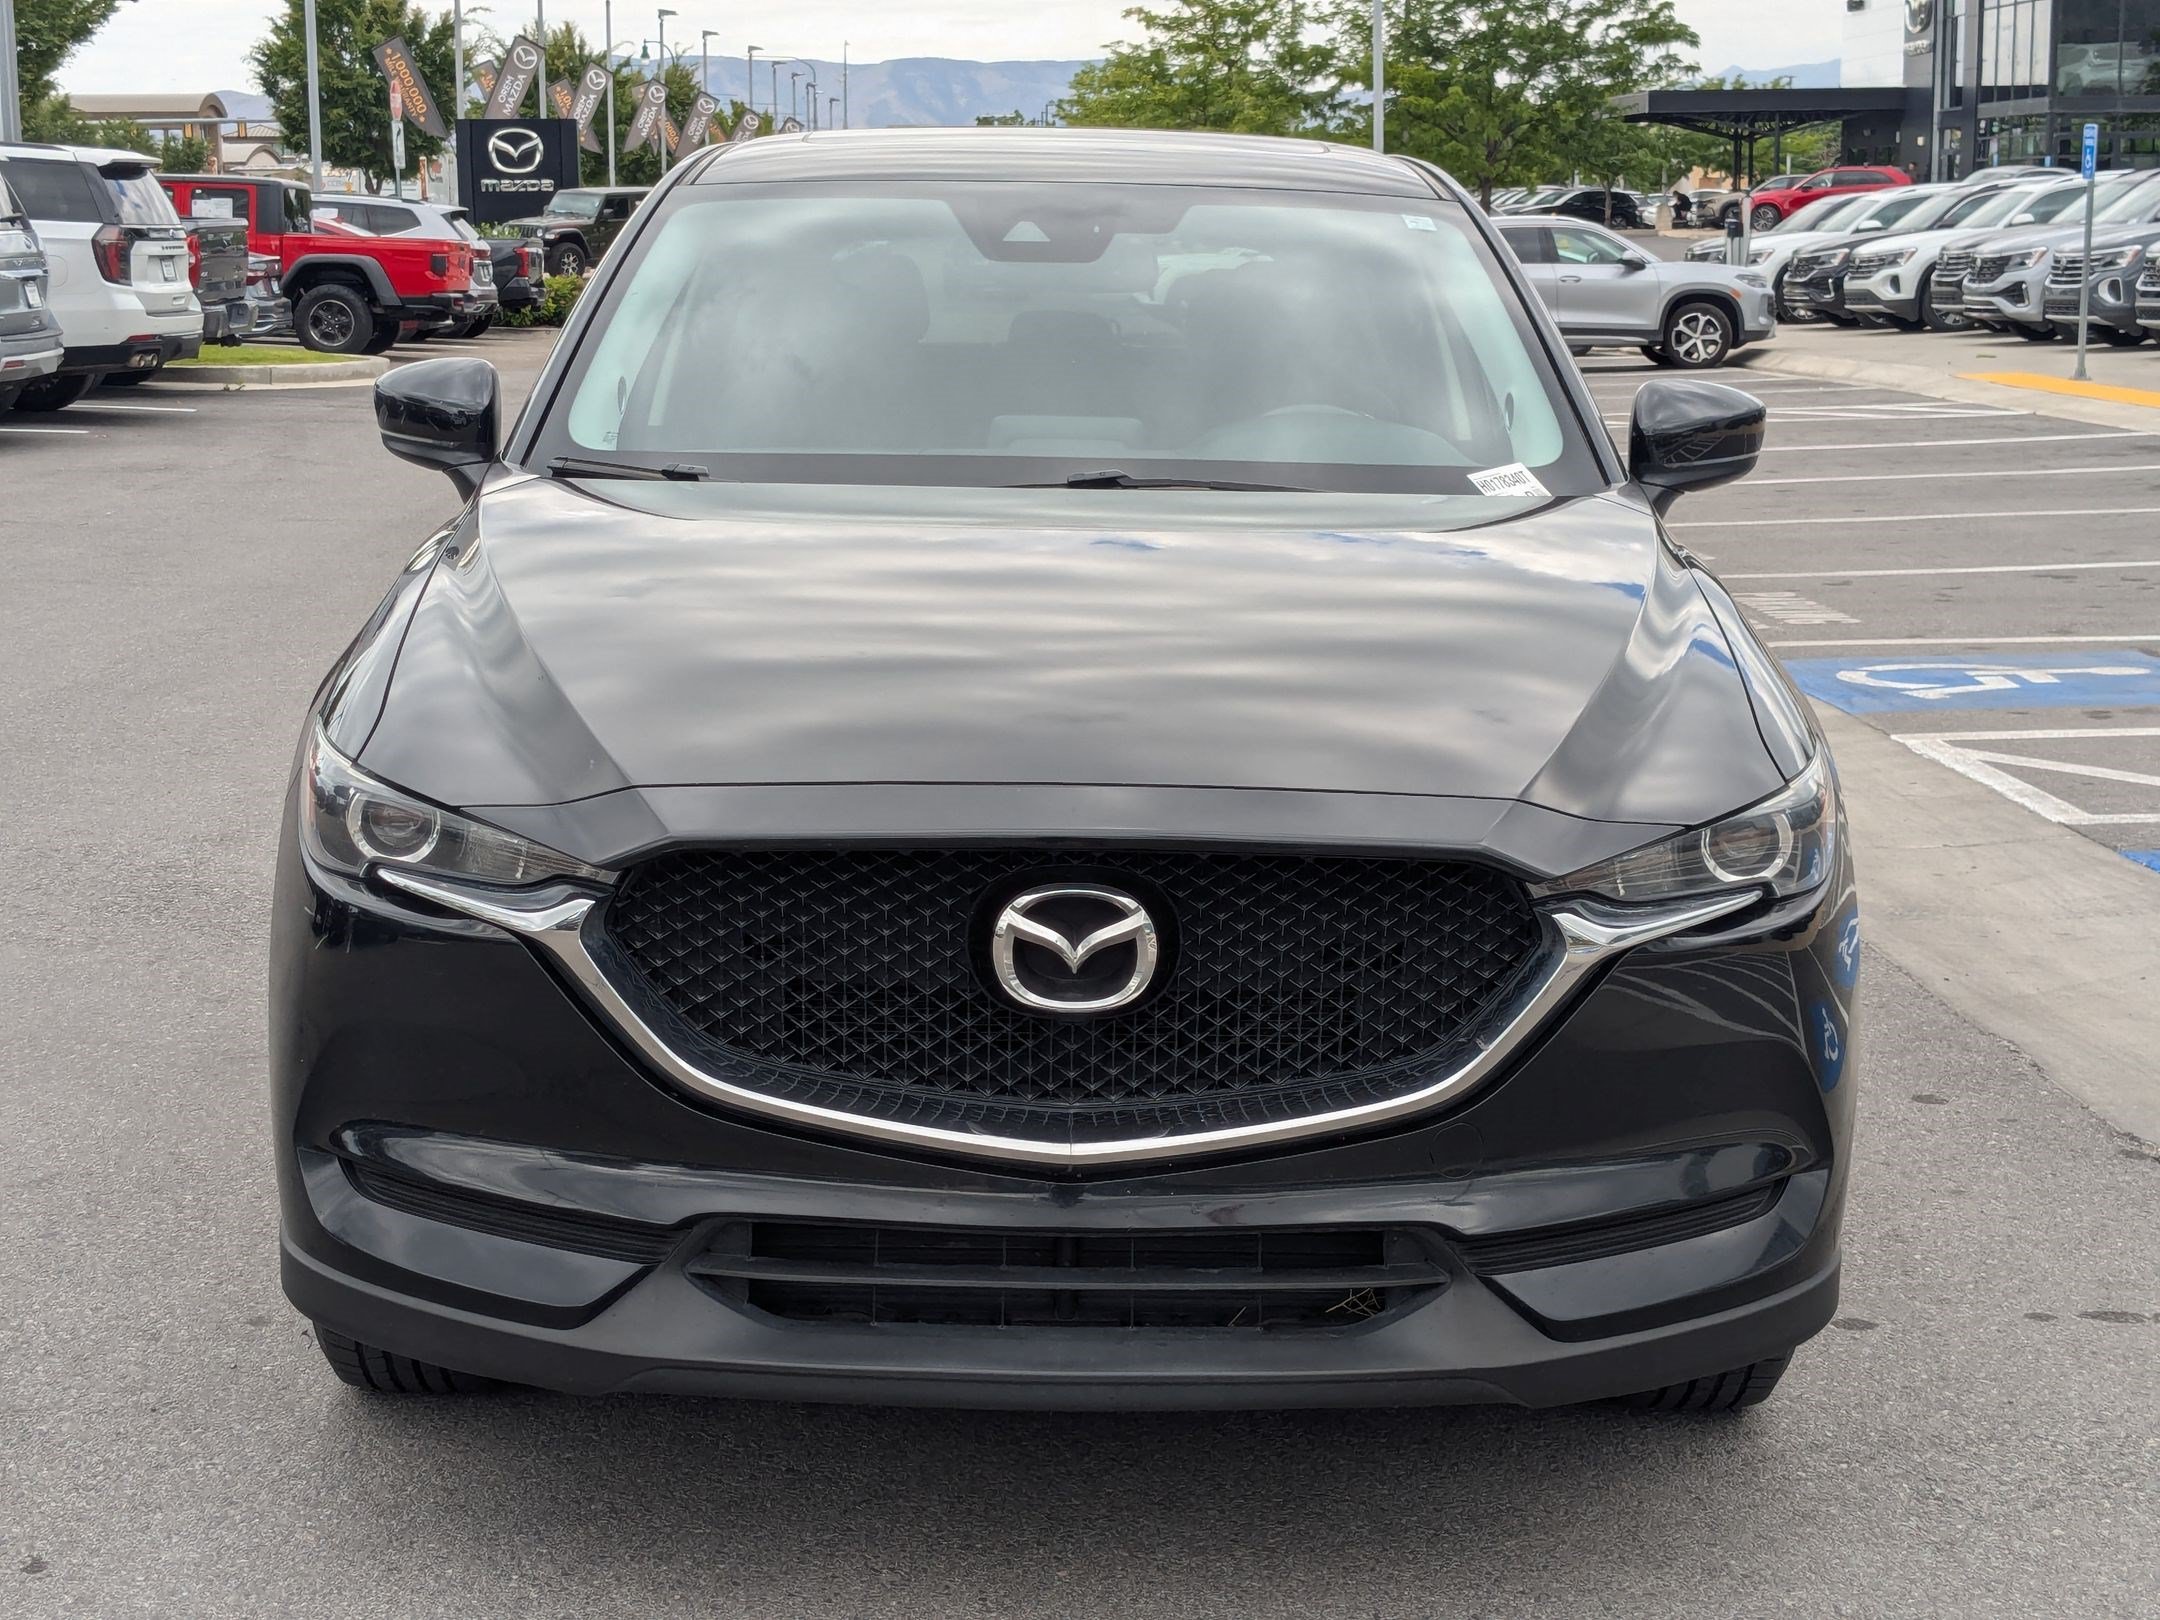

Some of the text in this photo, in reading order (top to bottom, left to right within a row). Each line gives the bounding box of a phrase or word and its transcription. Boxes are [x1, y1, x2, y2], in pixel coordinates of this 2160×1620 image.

[391, 52, 427, 113] 1,000,000
[498, 75, 515, 103] OREM
[503, 74, 528, 116] MAZDA
[573, 95, 587, 120] OREM
[640, 106, 658, 137] MAZDA
[691, 116, 708, 144] MAZDA
